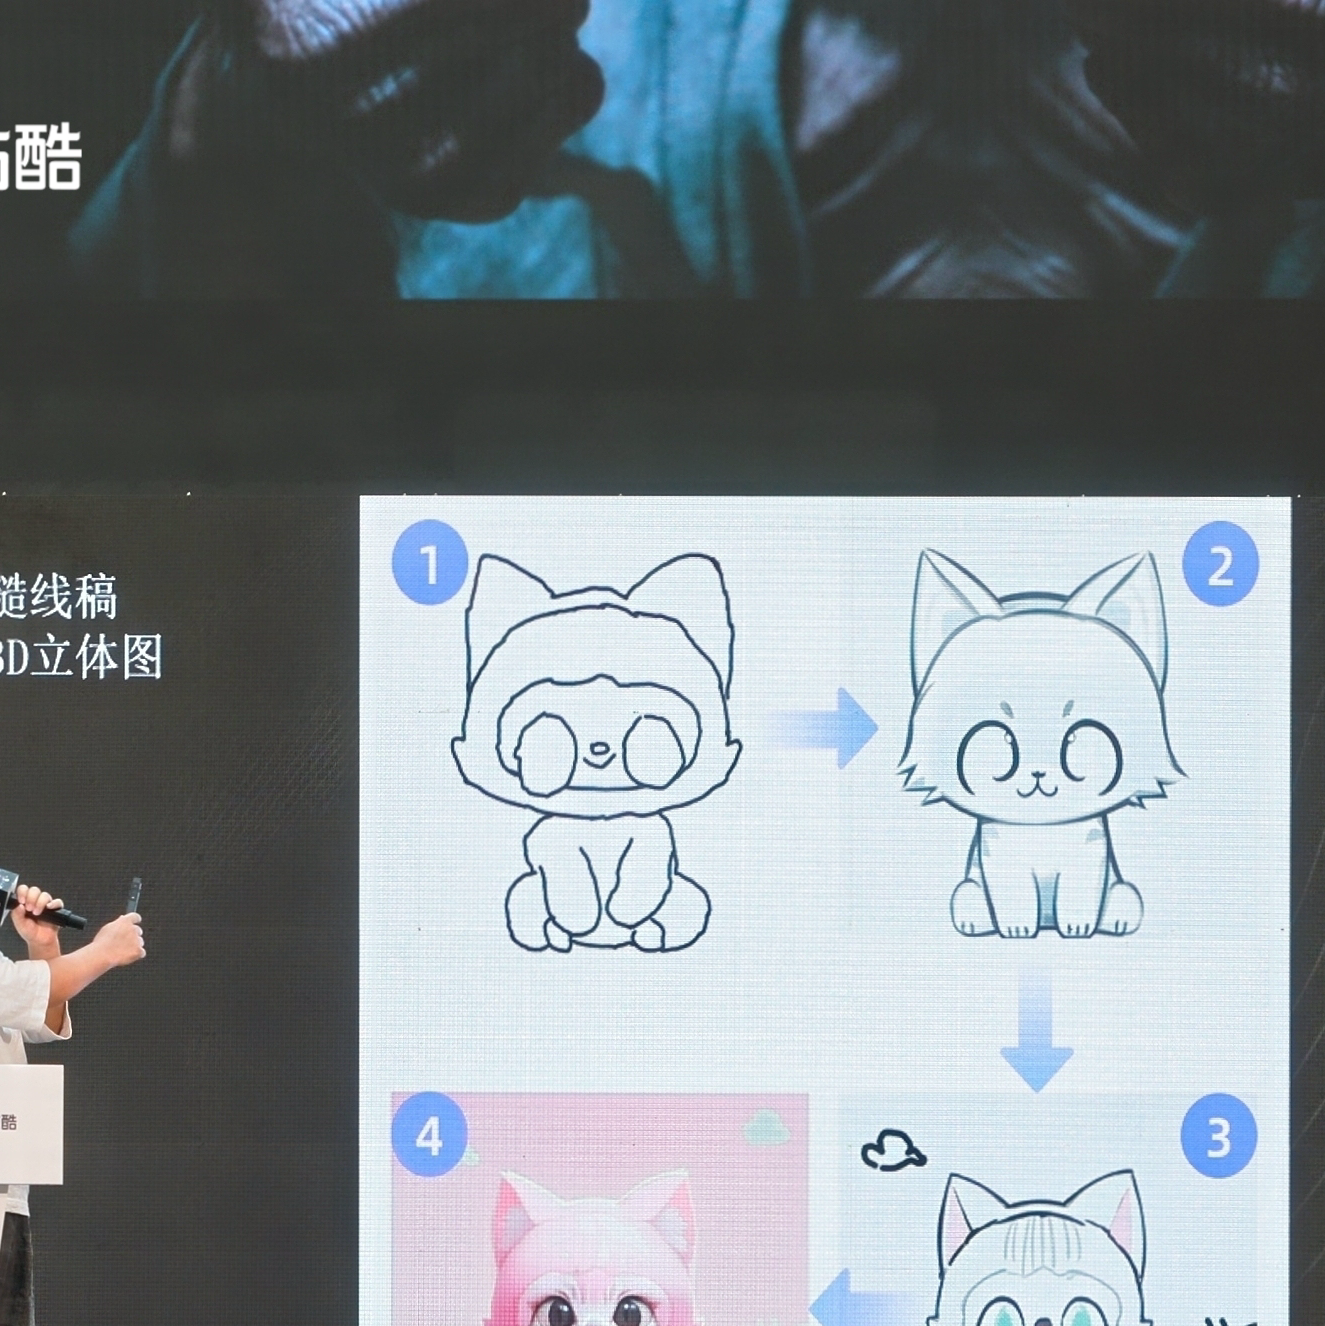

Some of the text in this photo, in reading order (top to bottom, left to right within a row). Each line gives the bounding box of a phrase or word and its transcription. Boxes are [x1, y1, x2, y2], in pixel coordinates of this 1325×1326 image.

[419, 544, 438, 586] 1
[1207, 545, 1236, 586] 2
[414, 1116, 444, 1156] 4
[1206, 1117, 1232, 1158] 3
